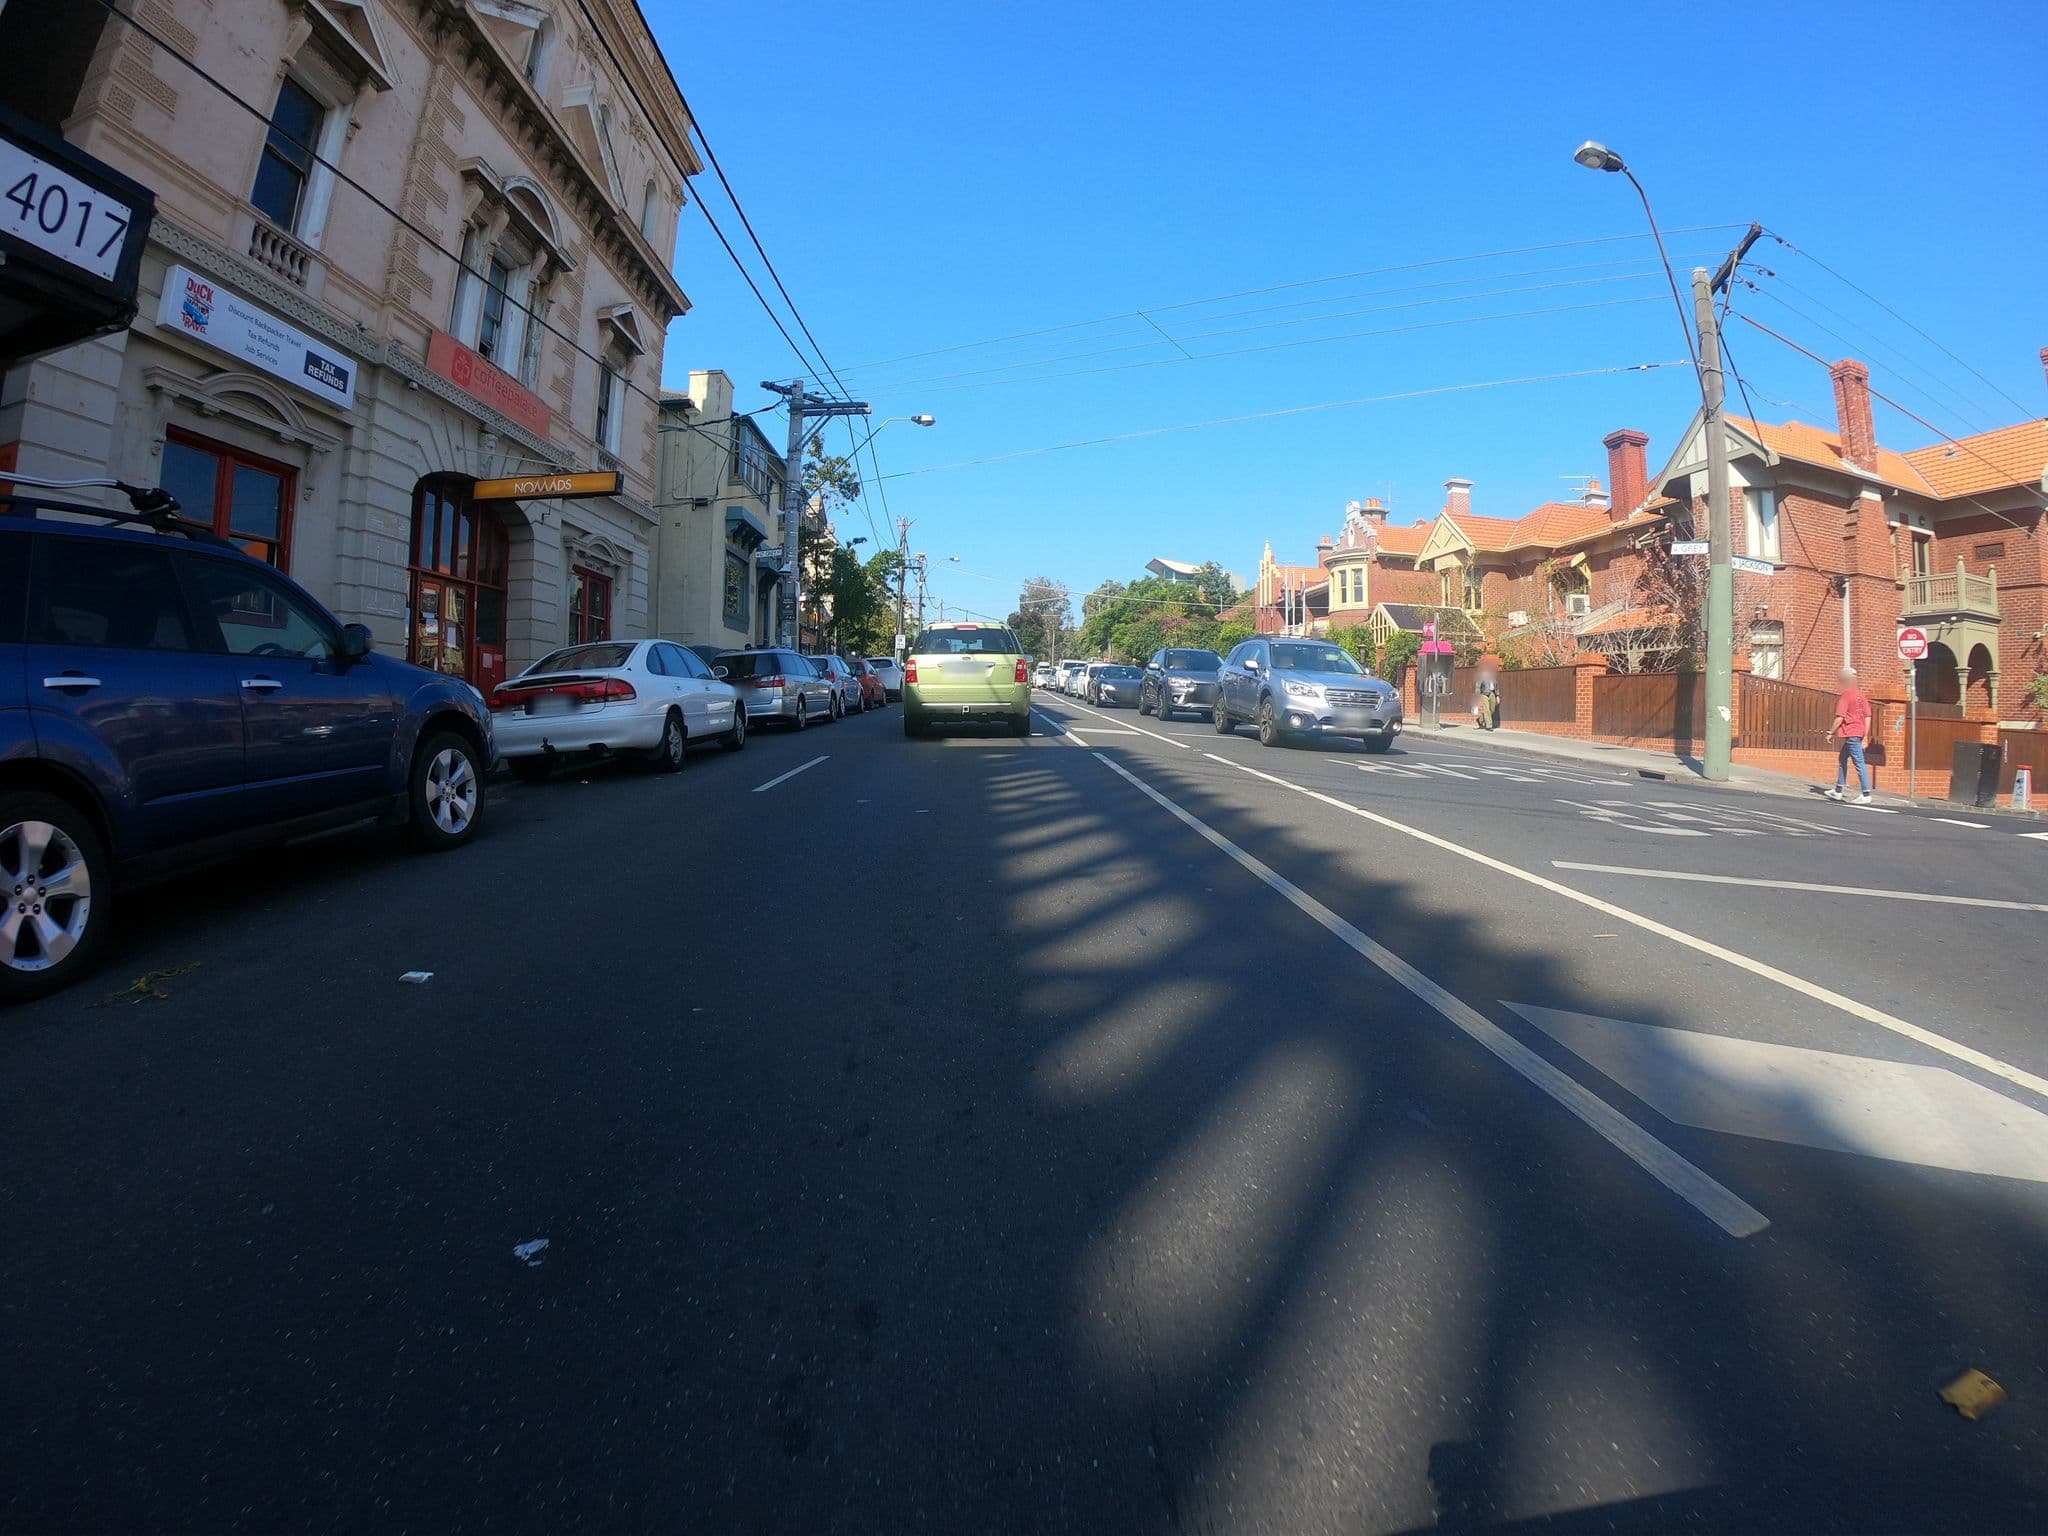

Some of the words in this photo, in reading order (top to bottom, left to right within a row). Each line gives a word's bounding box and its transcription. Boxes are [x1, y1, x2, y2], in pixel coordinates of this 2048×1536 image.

[5, 173, 130, 258] 4017
[187, 277, 215, 303] DUCK
[181, 311, 208, 335] TRAVEL
[228, 304, 254, 324] Discount
[254, 318, 286, 339] Backpacker
[286, 334, 302, 348] Travel
[247, 329, 257, 341] Tax
[257, 334, 281, 352] Refunds
[244, 344, 256, 355] Job
[256, 349, 278, 366] Services
[308, 364, 345, 389] REFUNDS
[320, 360, 336, 375] TAX
[514, 477, 572, 494] NOMADS
[1681, 543, 1704, 553] GREY
[1738, 558, 1769, 573] JACKSON
